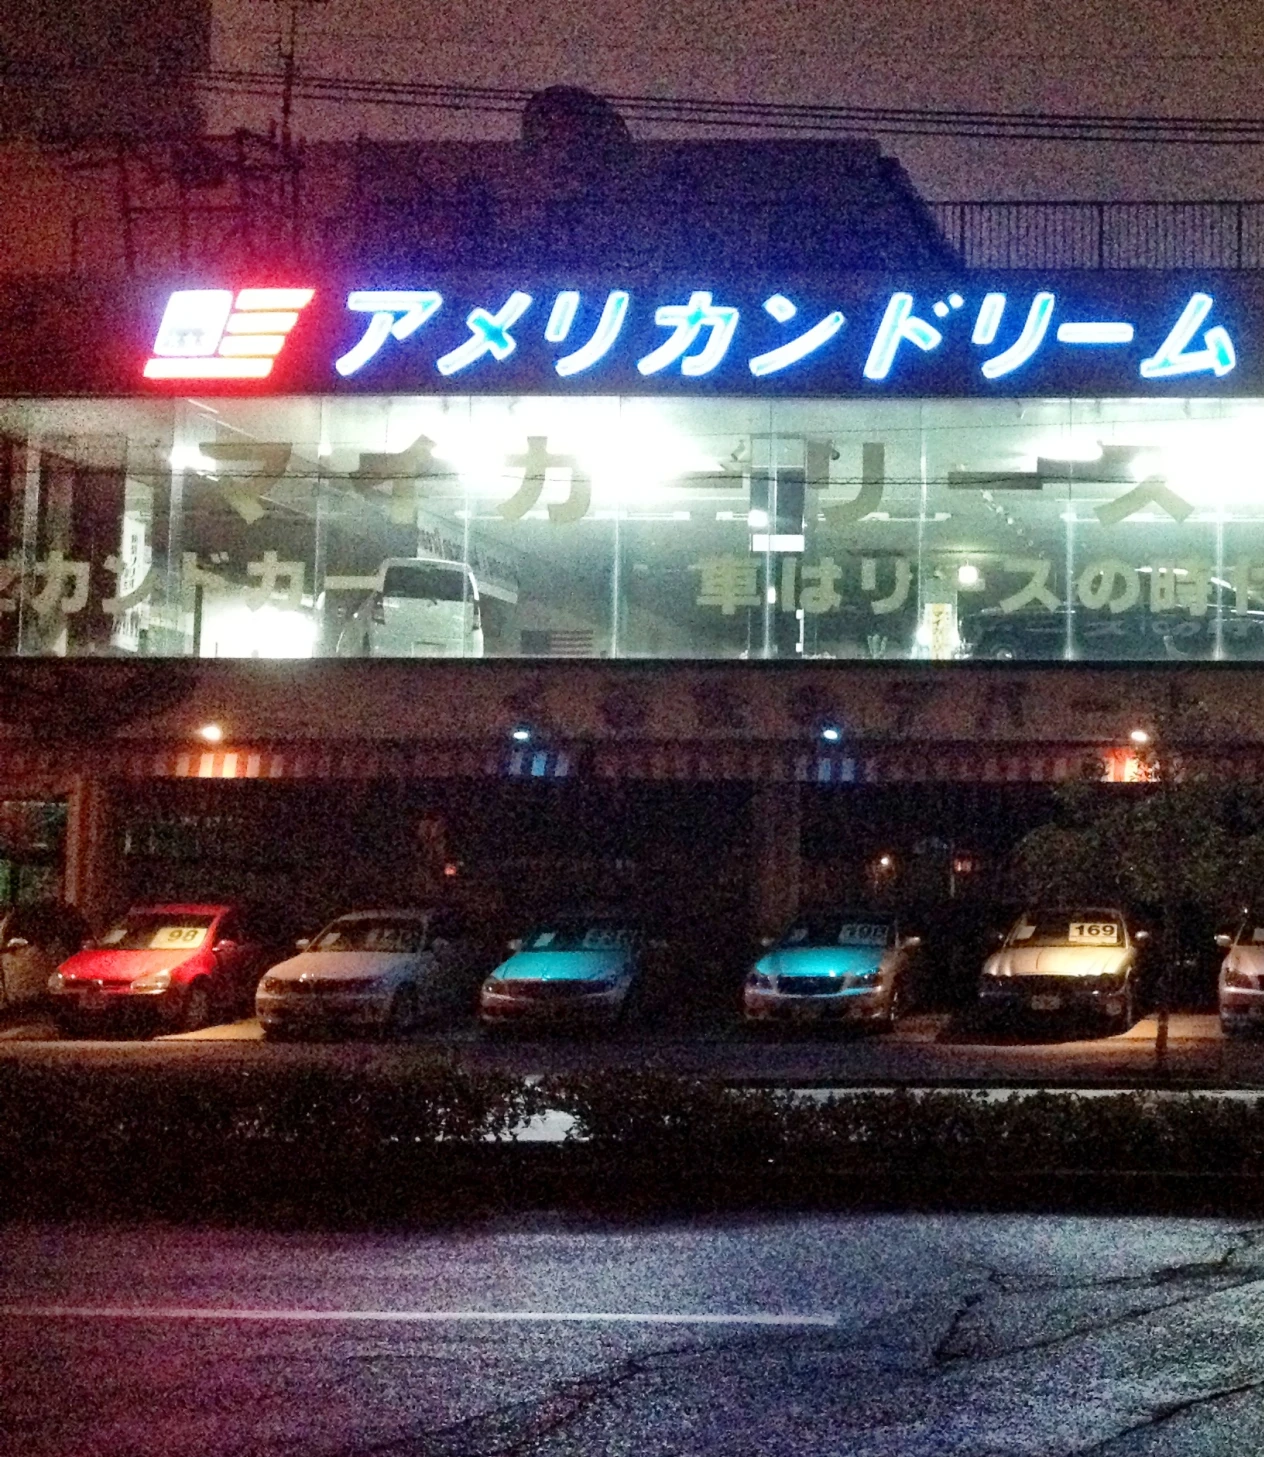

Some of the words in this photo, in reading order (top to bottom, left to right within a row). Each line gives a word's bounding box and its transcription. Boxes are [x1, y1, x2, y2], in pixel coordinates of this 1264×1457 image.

[335, 289, 1237, 380] アメリカンドリーム
[198, 434, 1196, 524] マイカーリース
[168, 929, 198, 942] 98
[1075, 924, 1115, 936] 169
